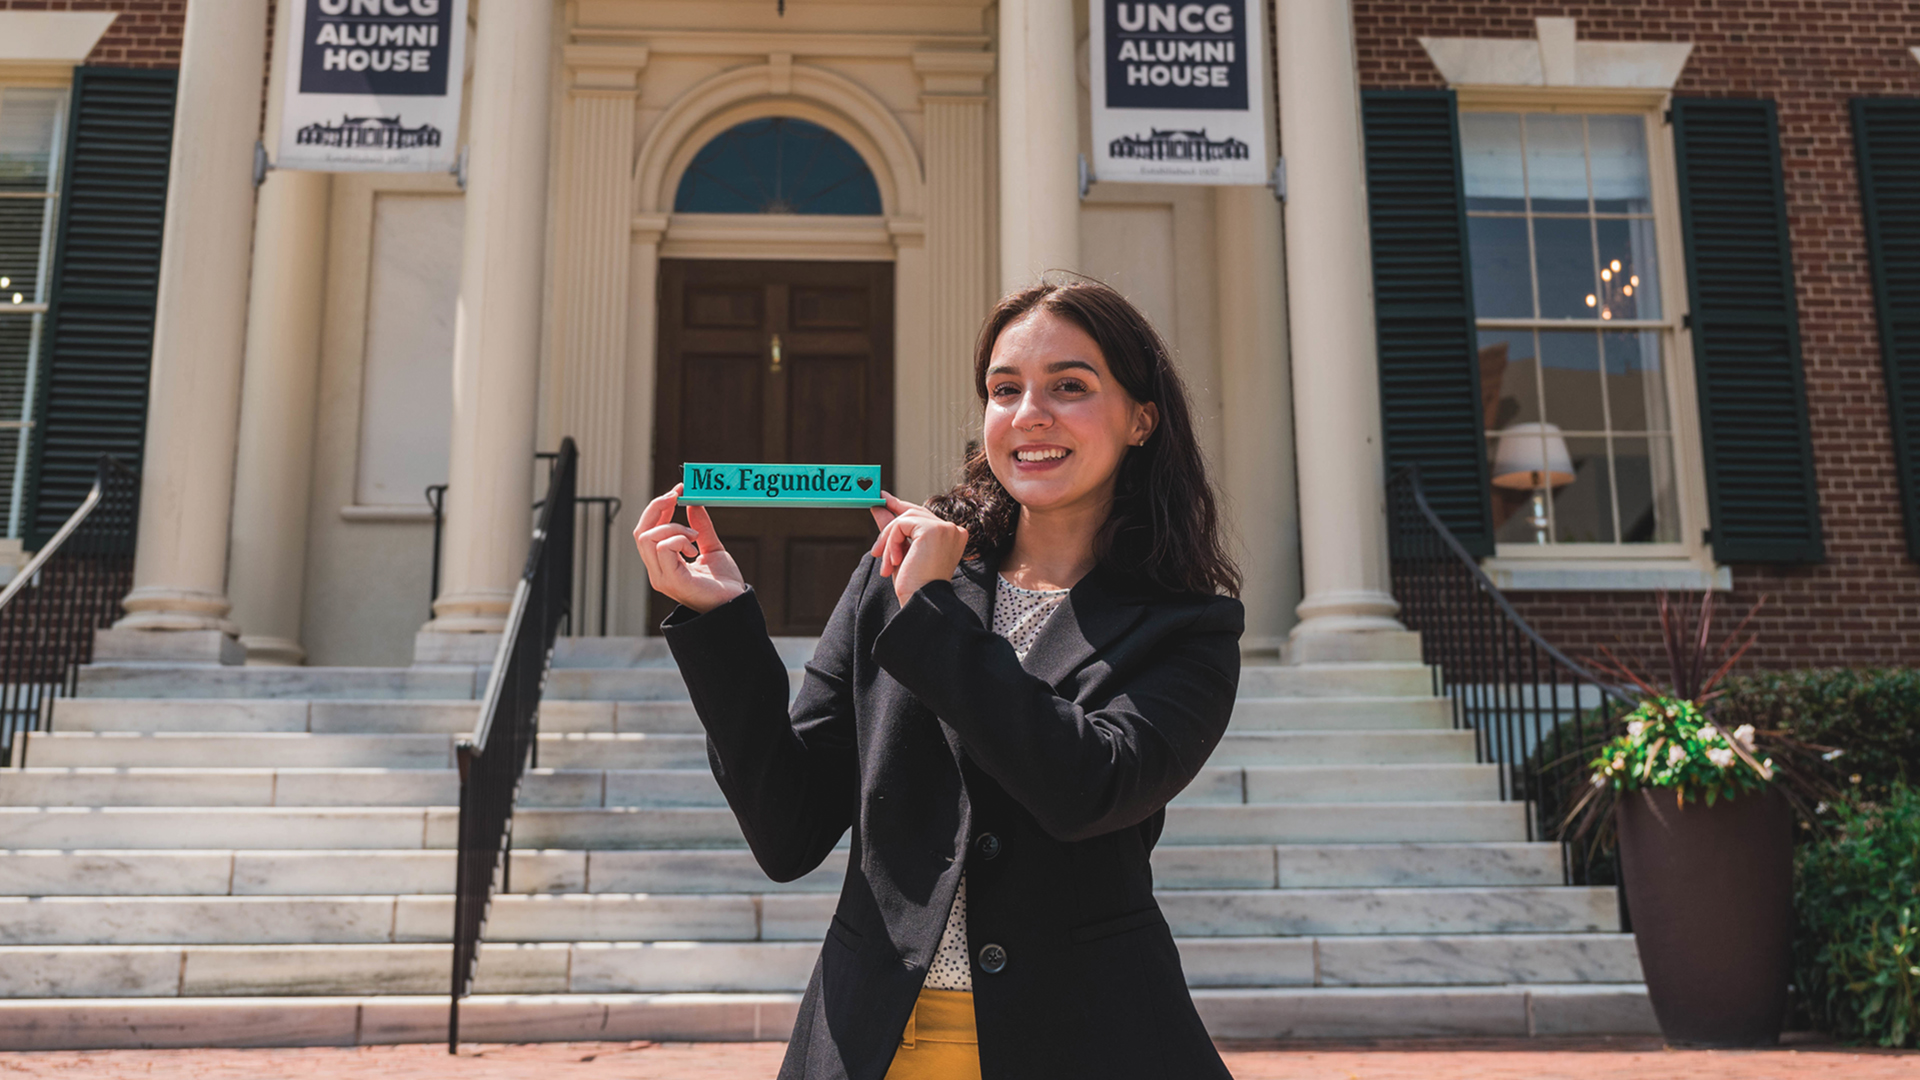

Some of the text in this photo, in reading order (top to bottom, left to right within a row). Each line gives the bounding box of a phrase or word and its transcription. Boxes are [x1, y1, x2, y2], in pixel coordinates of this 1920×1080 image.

[1117, 3, 1233, 33] UNCG
[316, 23, 438, 47] ALUMNI
[323, 48, 430, 72] HOUSE
[1118, 40, 1235, 63] ALUMNI
[1127, 65, 1229, 87] HOUSE
[691, 468, 852, 498] Ms. Fagundez
